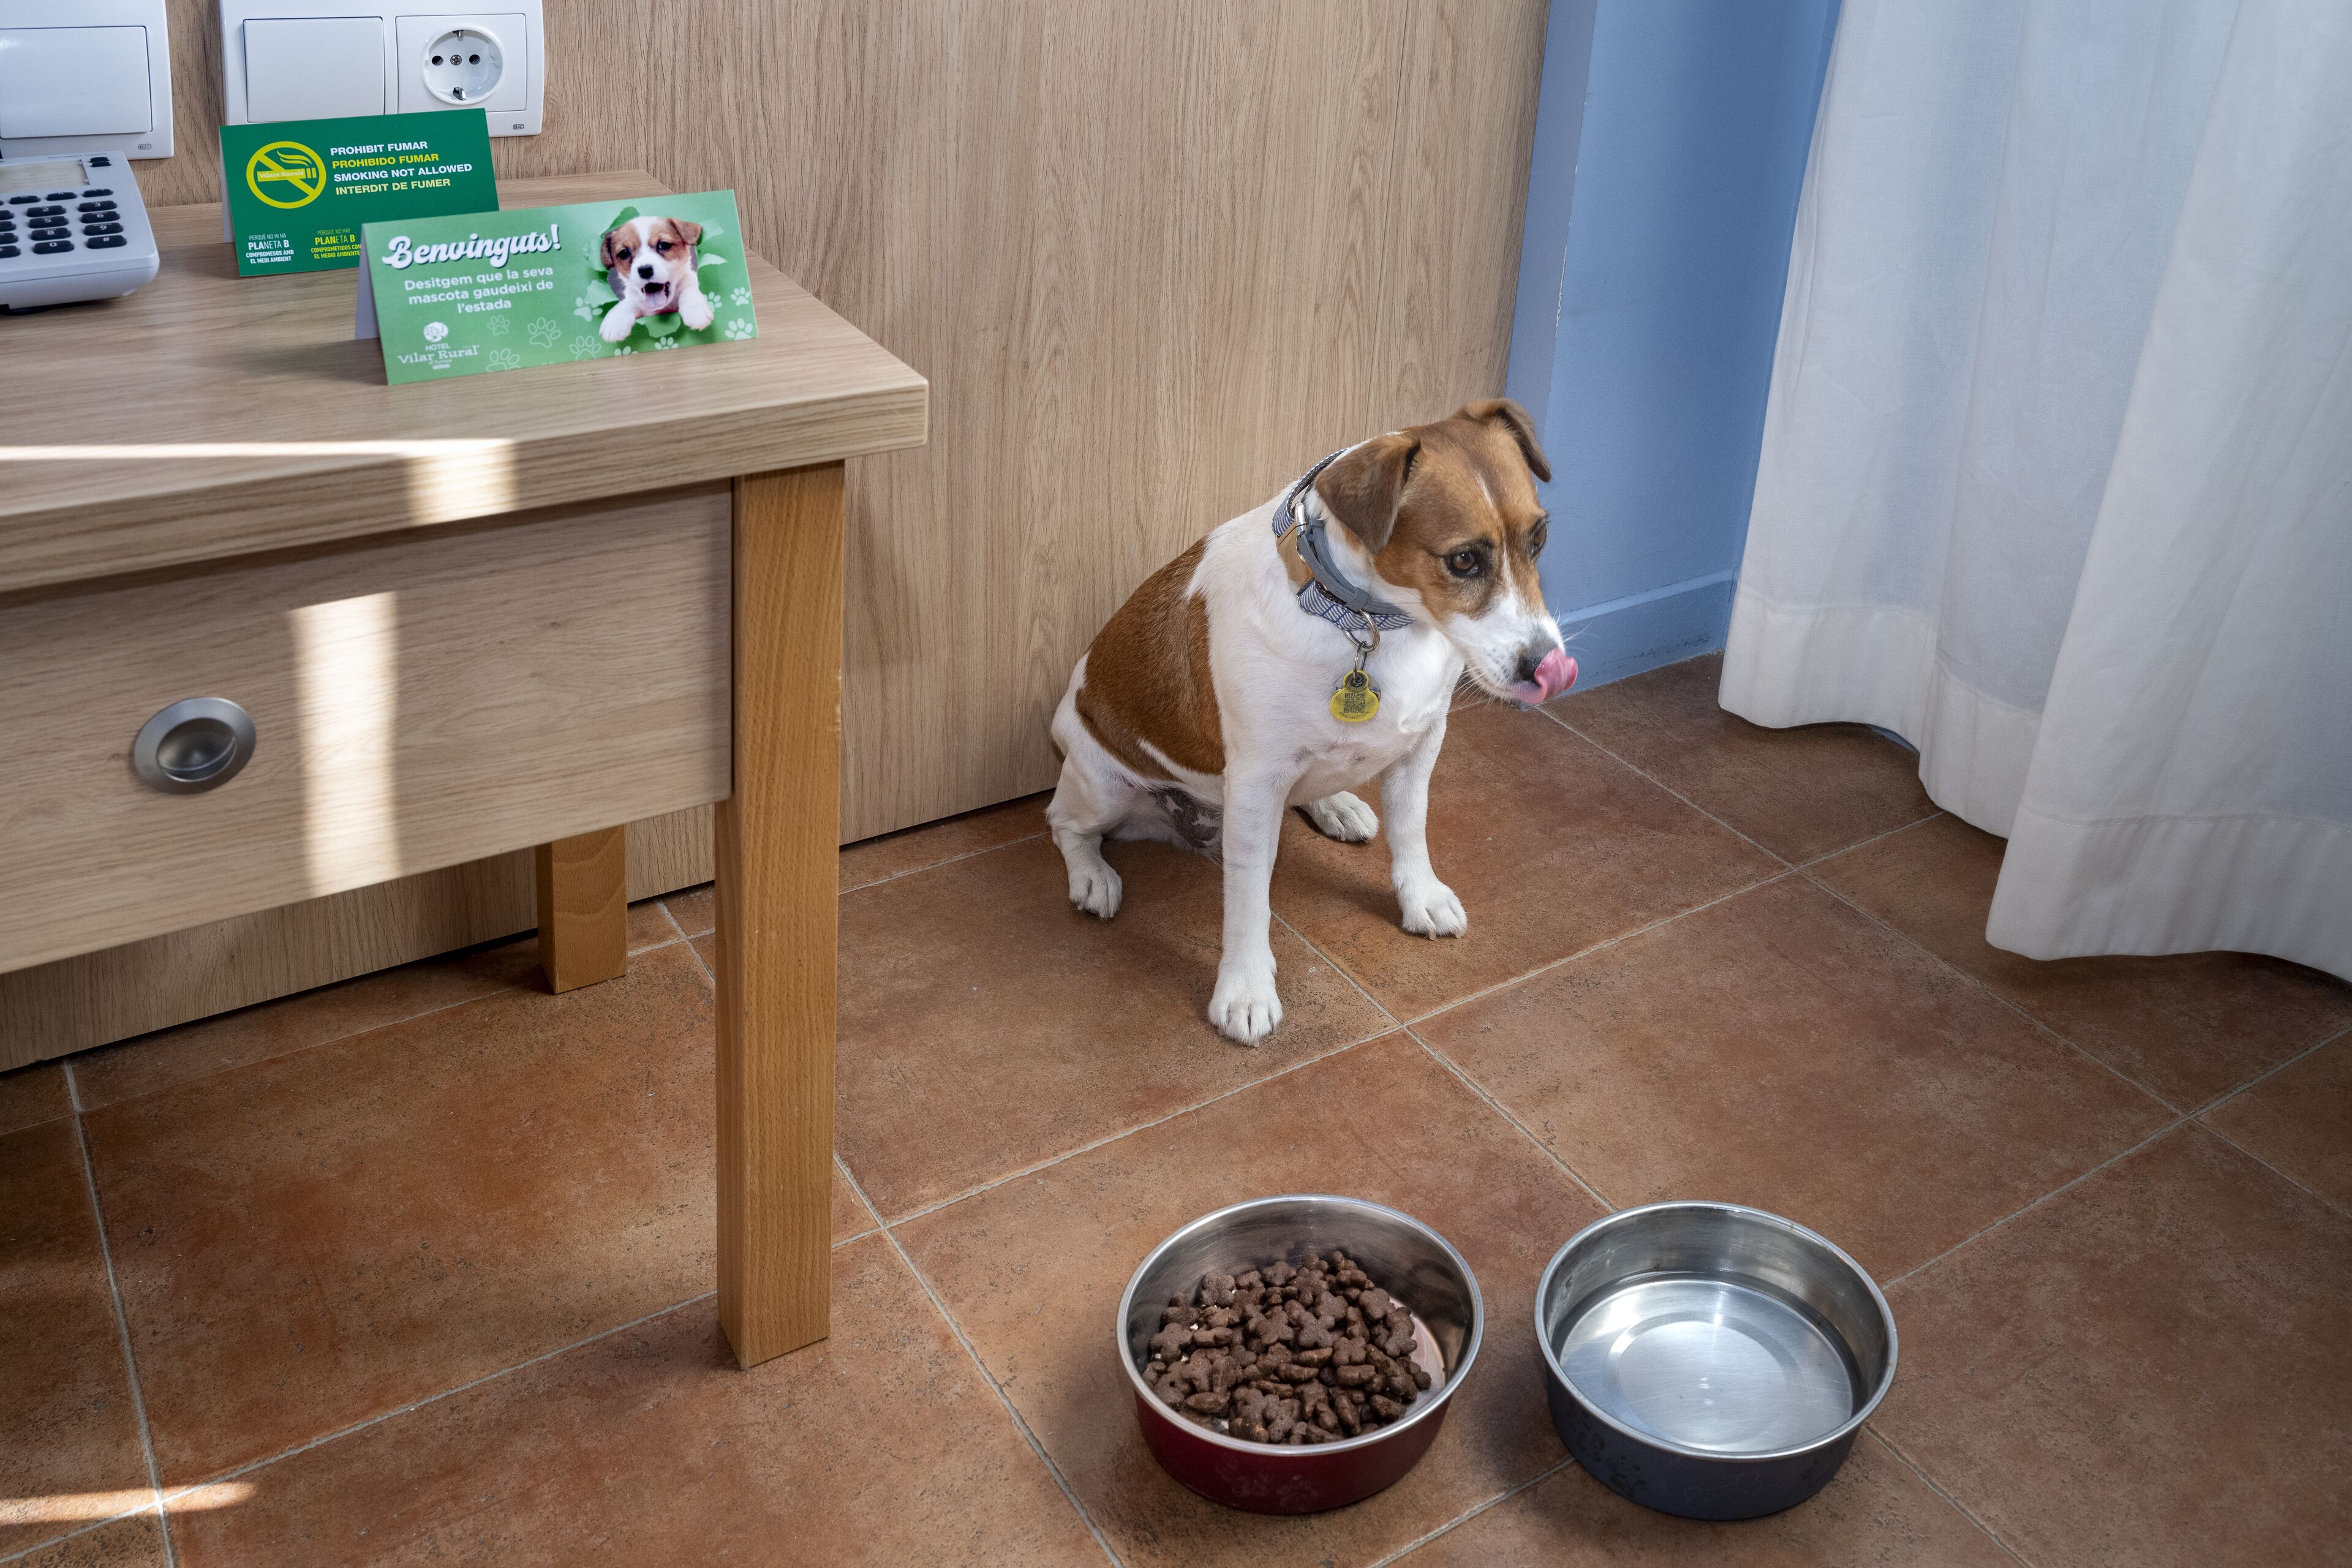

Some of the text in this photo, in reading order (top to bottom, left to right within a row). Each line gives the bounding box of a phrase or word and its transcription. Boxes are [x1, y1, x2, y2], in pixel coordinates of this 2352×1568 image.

[330, 141, 428, 156] PROHIBIT FUMAR
[332, 153, 439, 169] PROHIBIDO FUMAR
[334, 164, 472, 182] SMOKING NOT ALLOWED
[336, 178, 451, 195] INTERDIT DE FUMER
[248, 239, 290, 251] PLANETA B
[311, 244, 351, 254] COMPROMETIDOS
[315, 236, 349, 246] PLANETA
[382, 224, 561, 270] Benvinguts!
[404, 267, 554, 291] Desitgem que la seva
[408, 279, 554, 304] mascota gaudeixi de
[457, 299, 512, 314] l'estada
[398, 345, 478, 364] Vilar Rural
[425, 343, 451, 352] HOTEL
